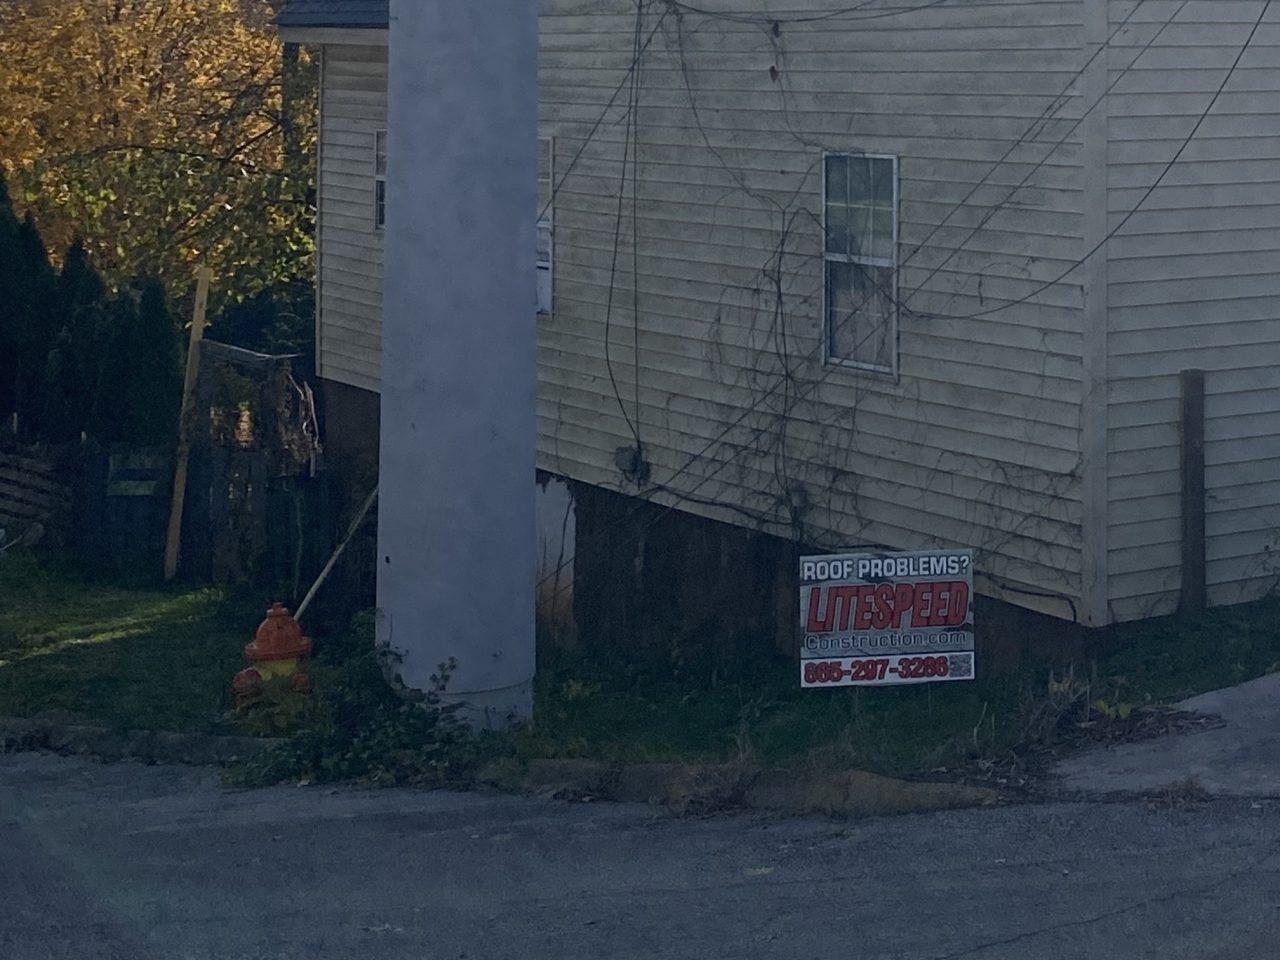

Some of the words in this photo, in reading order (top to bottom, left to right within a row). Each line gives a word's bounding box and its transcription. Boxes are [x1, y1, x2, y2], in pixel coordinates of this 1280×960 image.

[803, 561, 852, 581] ROOF
[858, 555, 970, 578] PROBLEMS?
[806, 581, 968, 632] LITESPEED
[804, 656, 948, 684] 865-297-3286
